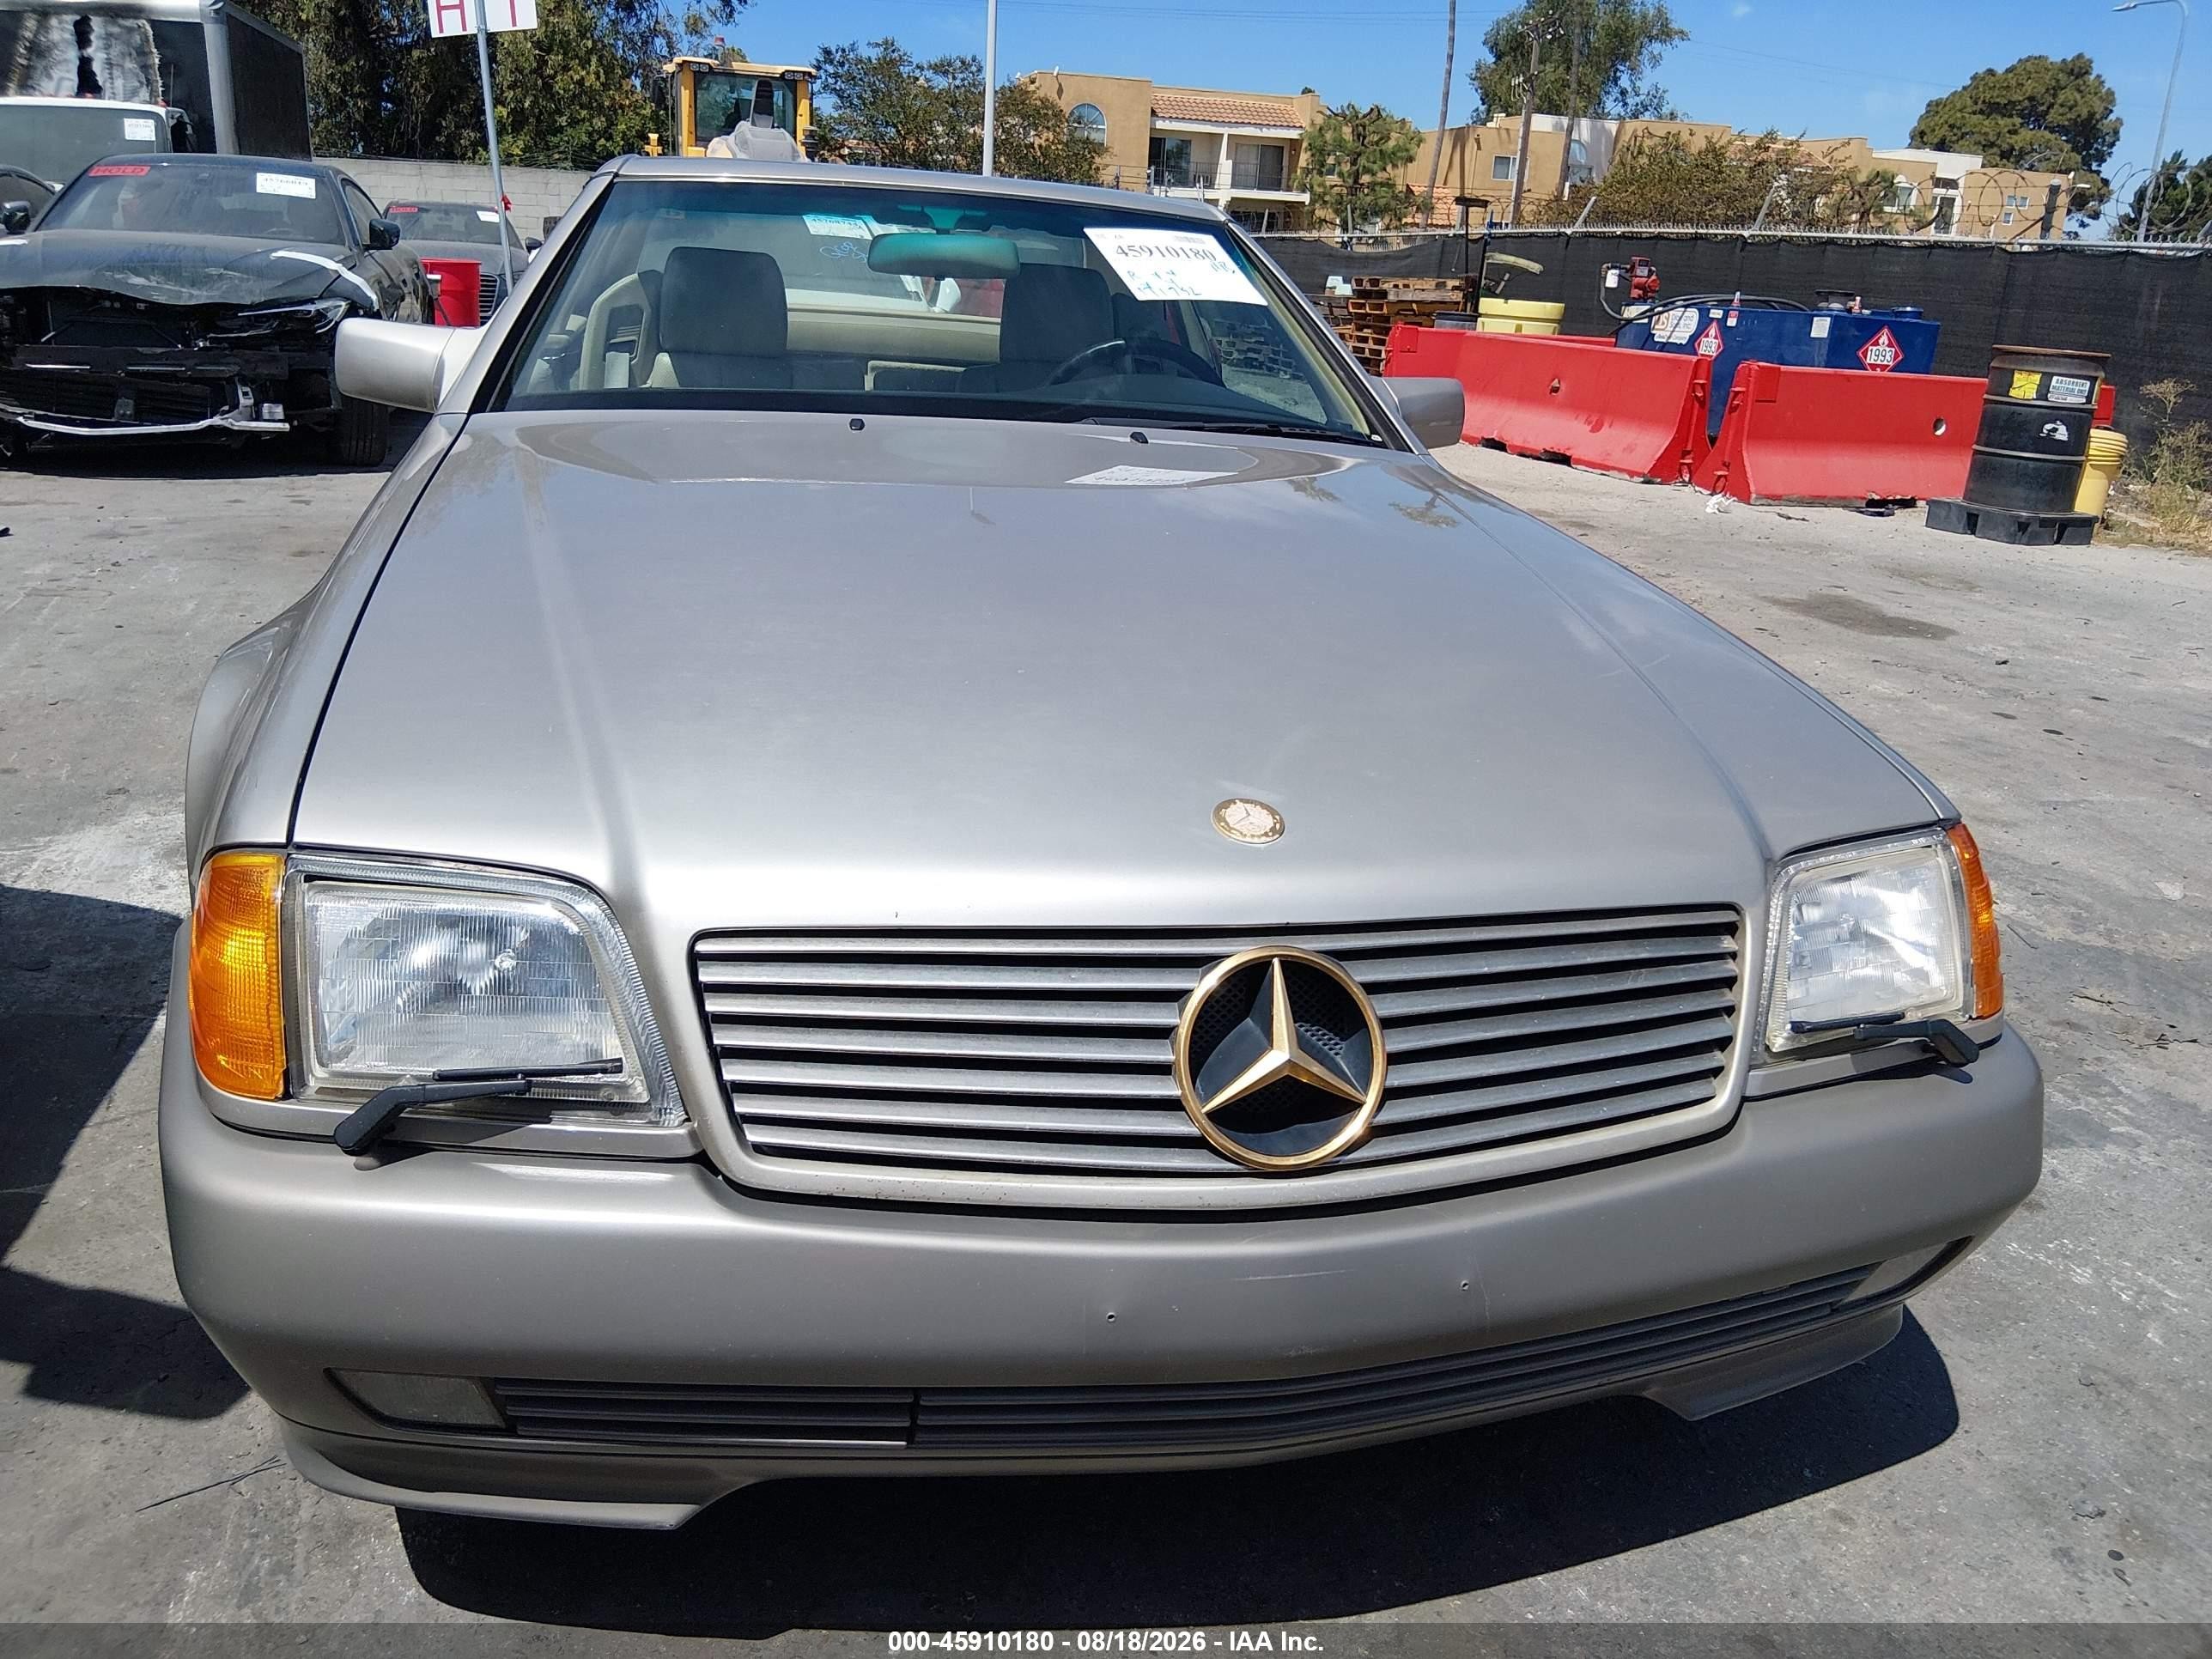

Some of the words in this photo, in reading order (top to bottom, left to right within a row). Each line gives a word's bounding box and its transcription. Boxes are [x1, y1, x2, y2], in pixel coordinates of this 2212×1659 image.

[1115, 244, 1217, 262] 45910180
[1700, 340, 1717, 355] 1993
[1869, 348, 1893, 363] 1993
[2055, 378, 2088, 388] ABSORBENT
